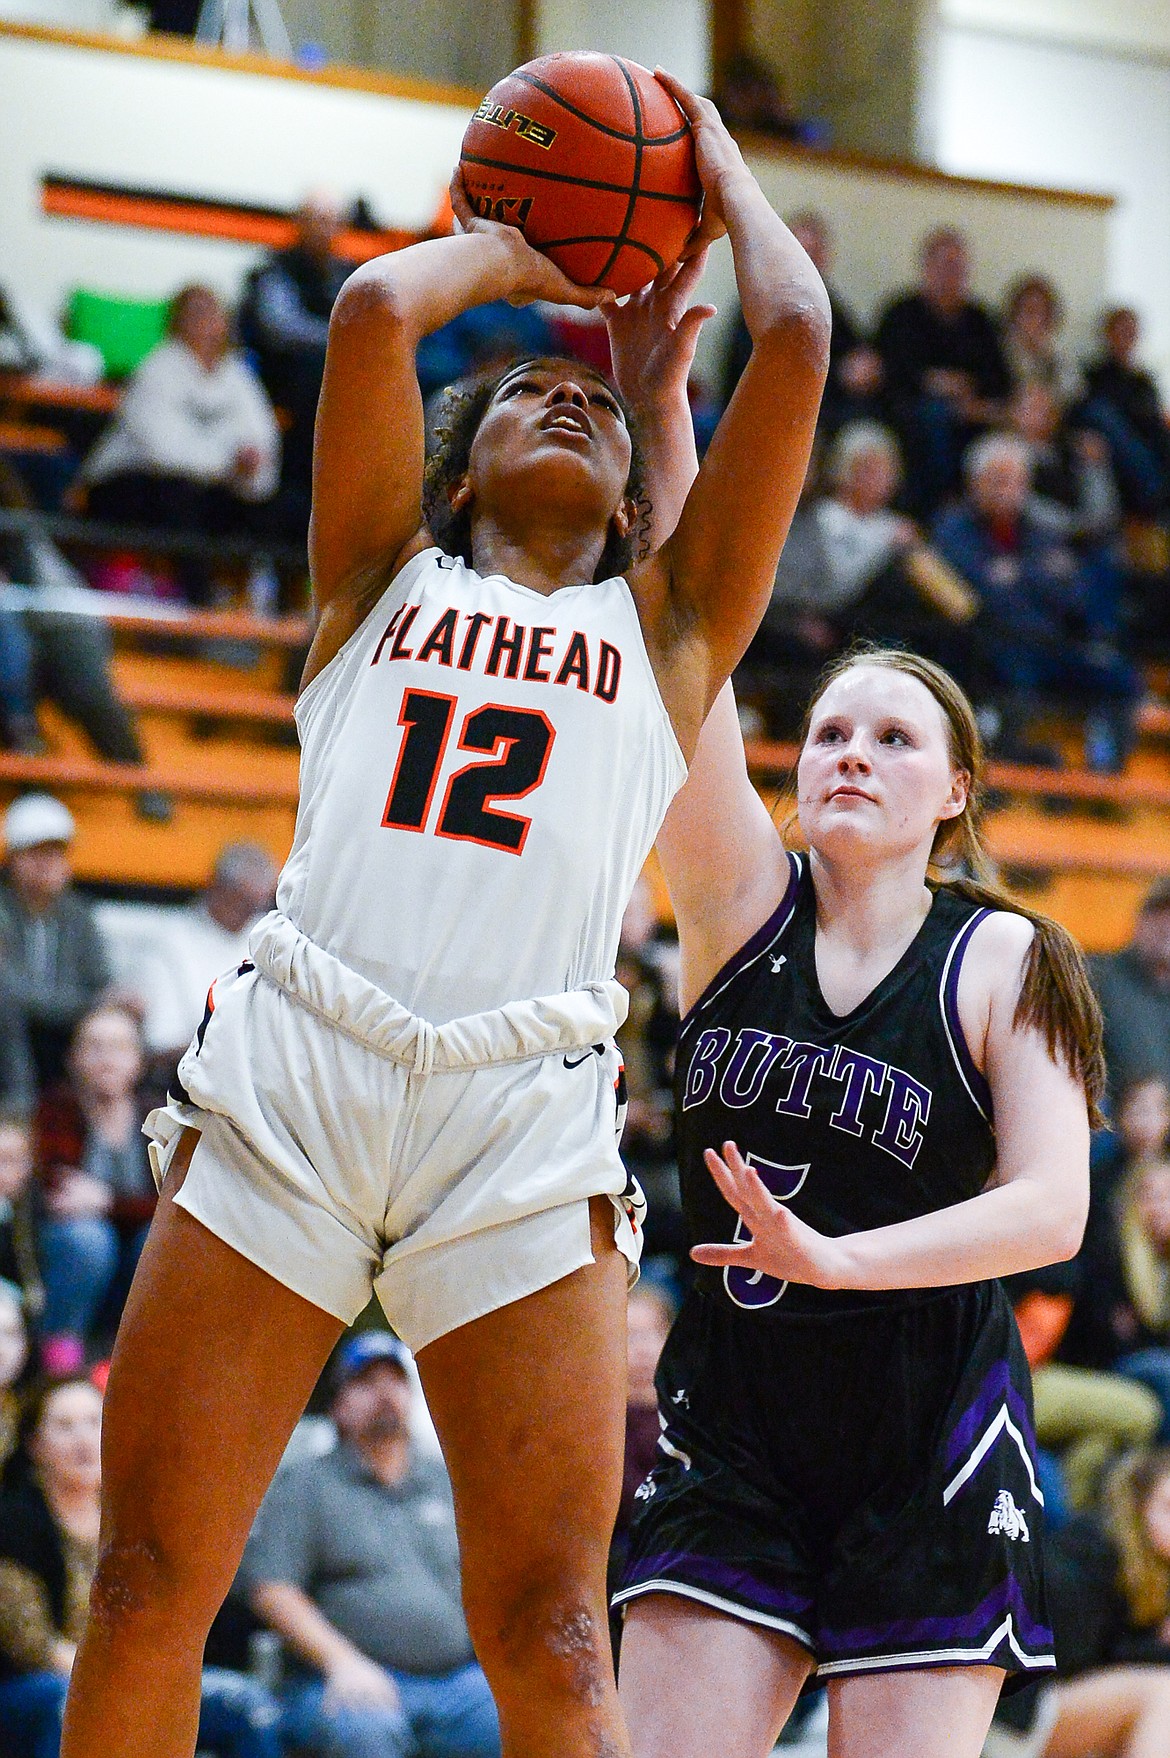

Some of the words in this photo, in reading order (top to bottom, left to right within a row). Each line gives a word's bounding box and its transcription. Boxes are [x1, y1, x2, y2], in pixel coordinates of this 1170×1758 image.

[473, 99, 558, 151] ELITE
[370, 603, 623, 705] FLATHEAD
[380, 687, 557, 857] 12
[682, 1026, 933, 1170] BUTTE
